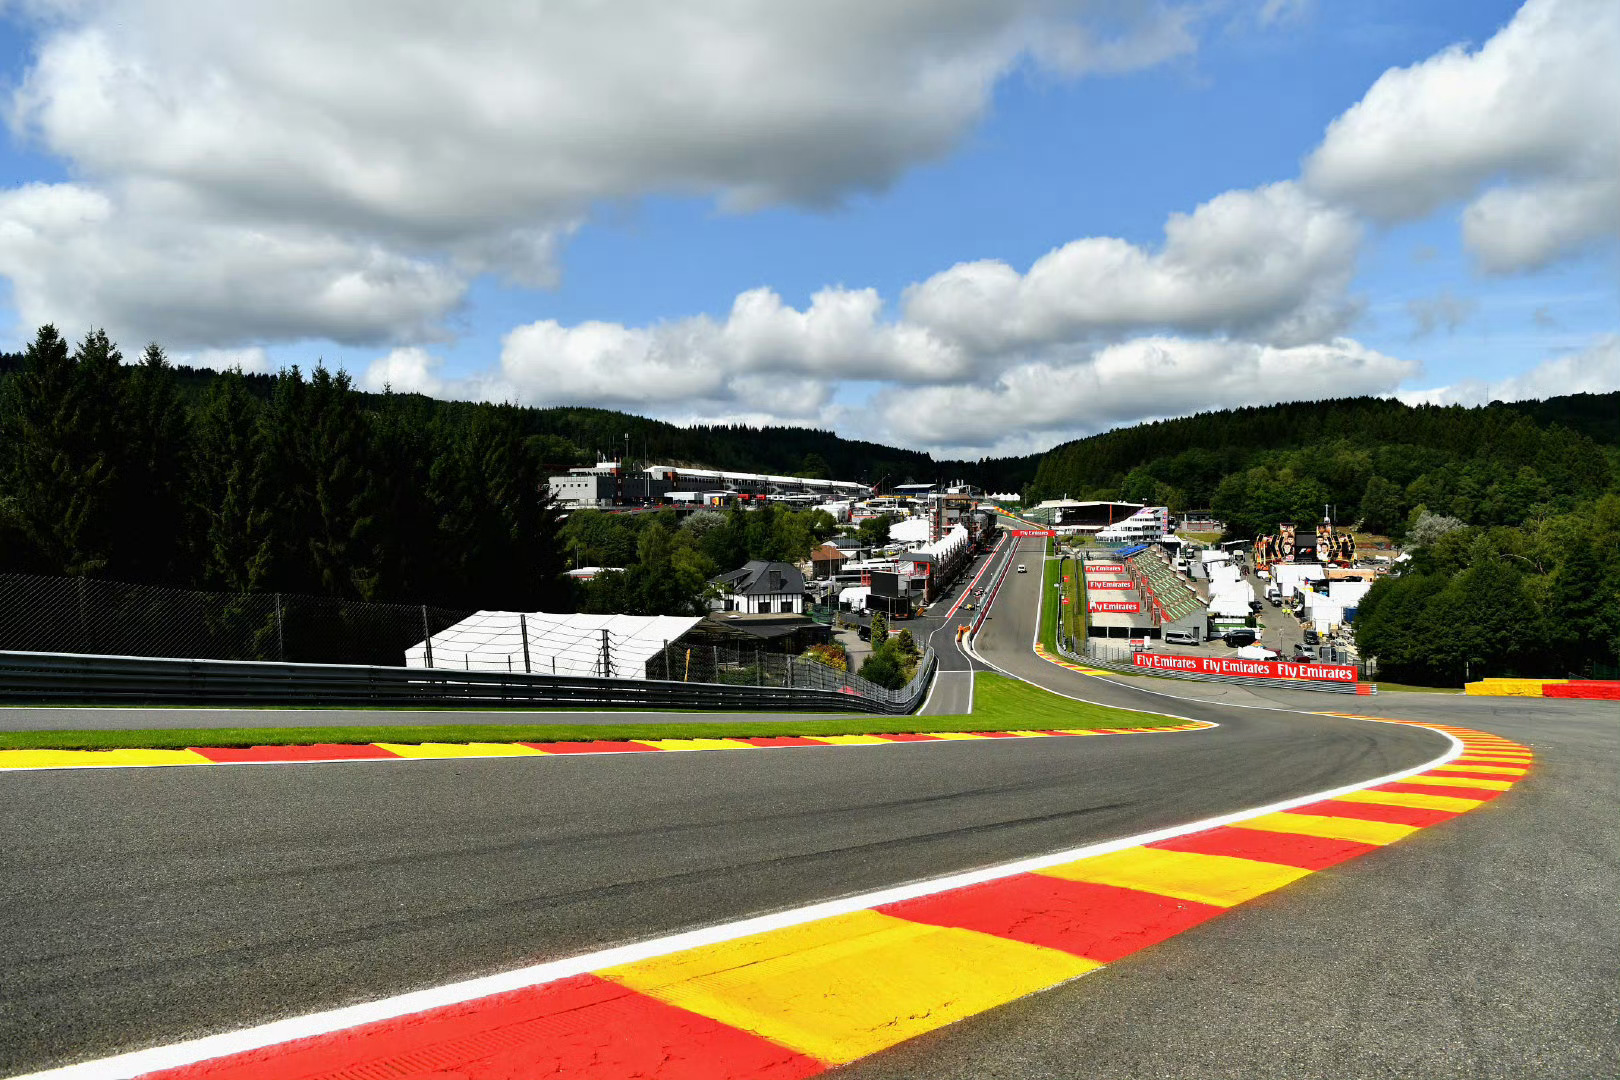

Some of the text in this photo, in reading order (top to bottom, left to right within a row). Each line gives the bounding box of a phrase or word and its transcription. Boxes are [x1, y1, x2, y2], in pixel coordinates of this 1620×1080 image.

[1137, 655, 1352, 680] Fly Emirates Fly Emirates Fly Emirates
